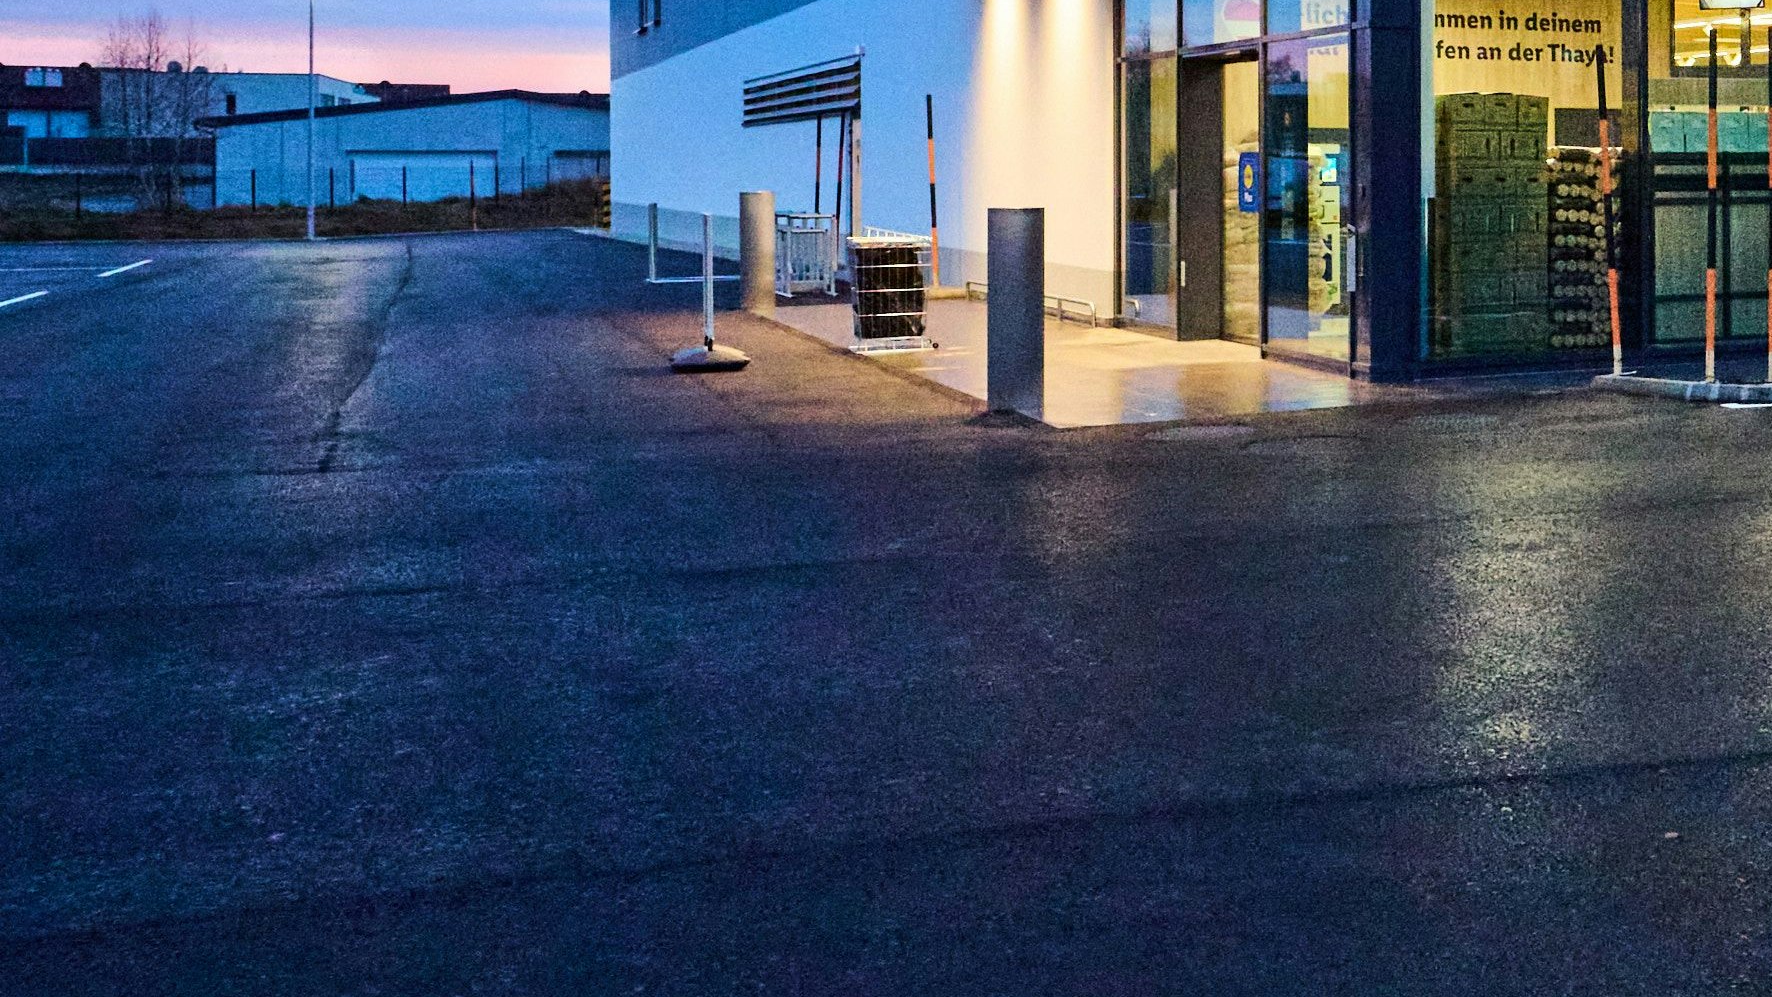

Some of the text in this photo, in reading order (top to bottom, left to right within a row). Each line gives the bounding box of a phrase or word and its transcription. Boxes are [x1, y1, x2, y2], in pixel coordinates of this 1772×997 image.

[1500, 10, 1519, 30] in
[1525, 12, 1601, 33] deinem
[1435, 40, 1470, 59] fen
[1477, 44, 1502, 60] an
[1508, 43, 1543, 62] der
